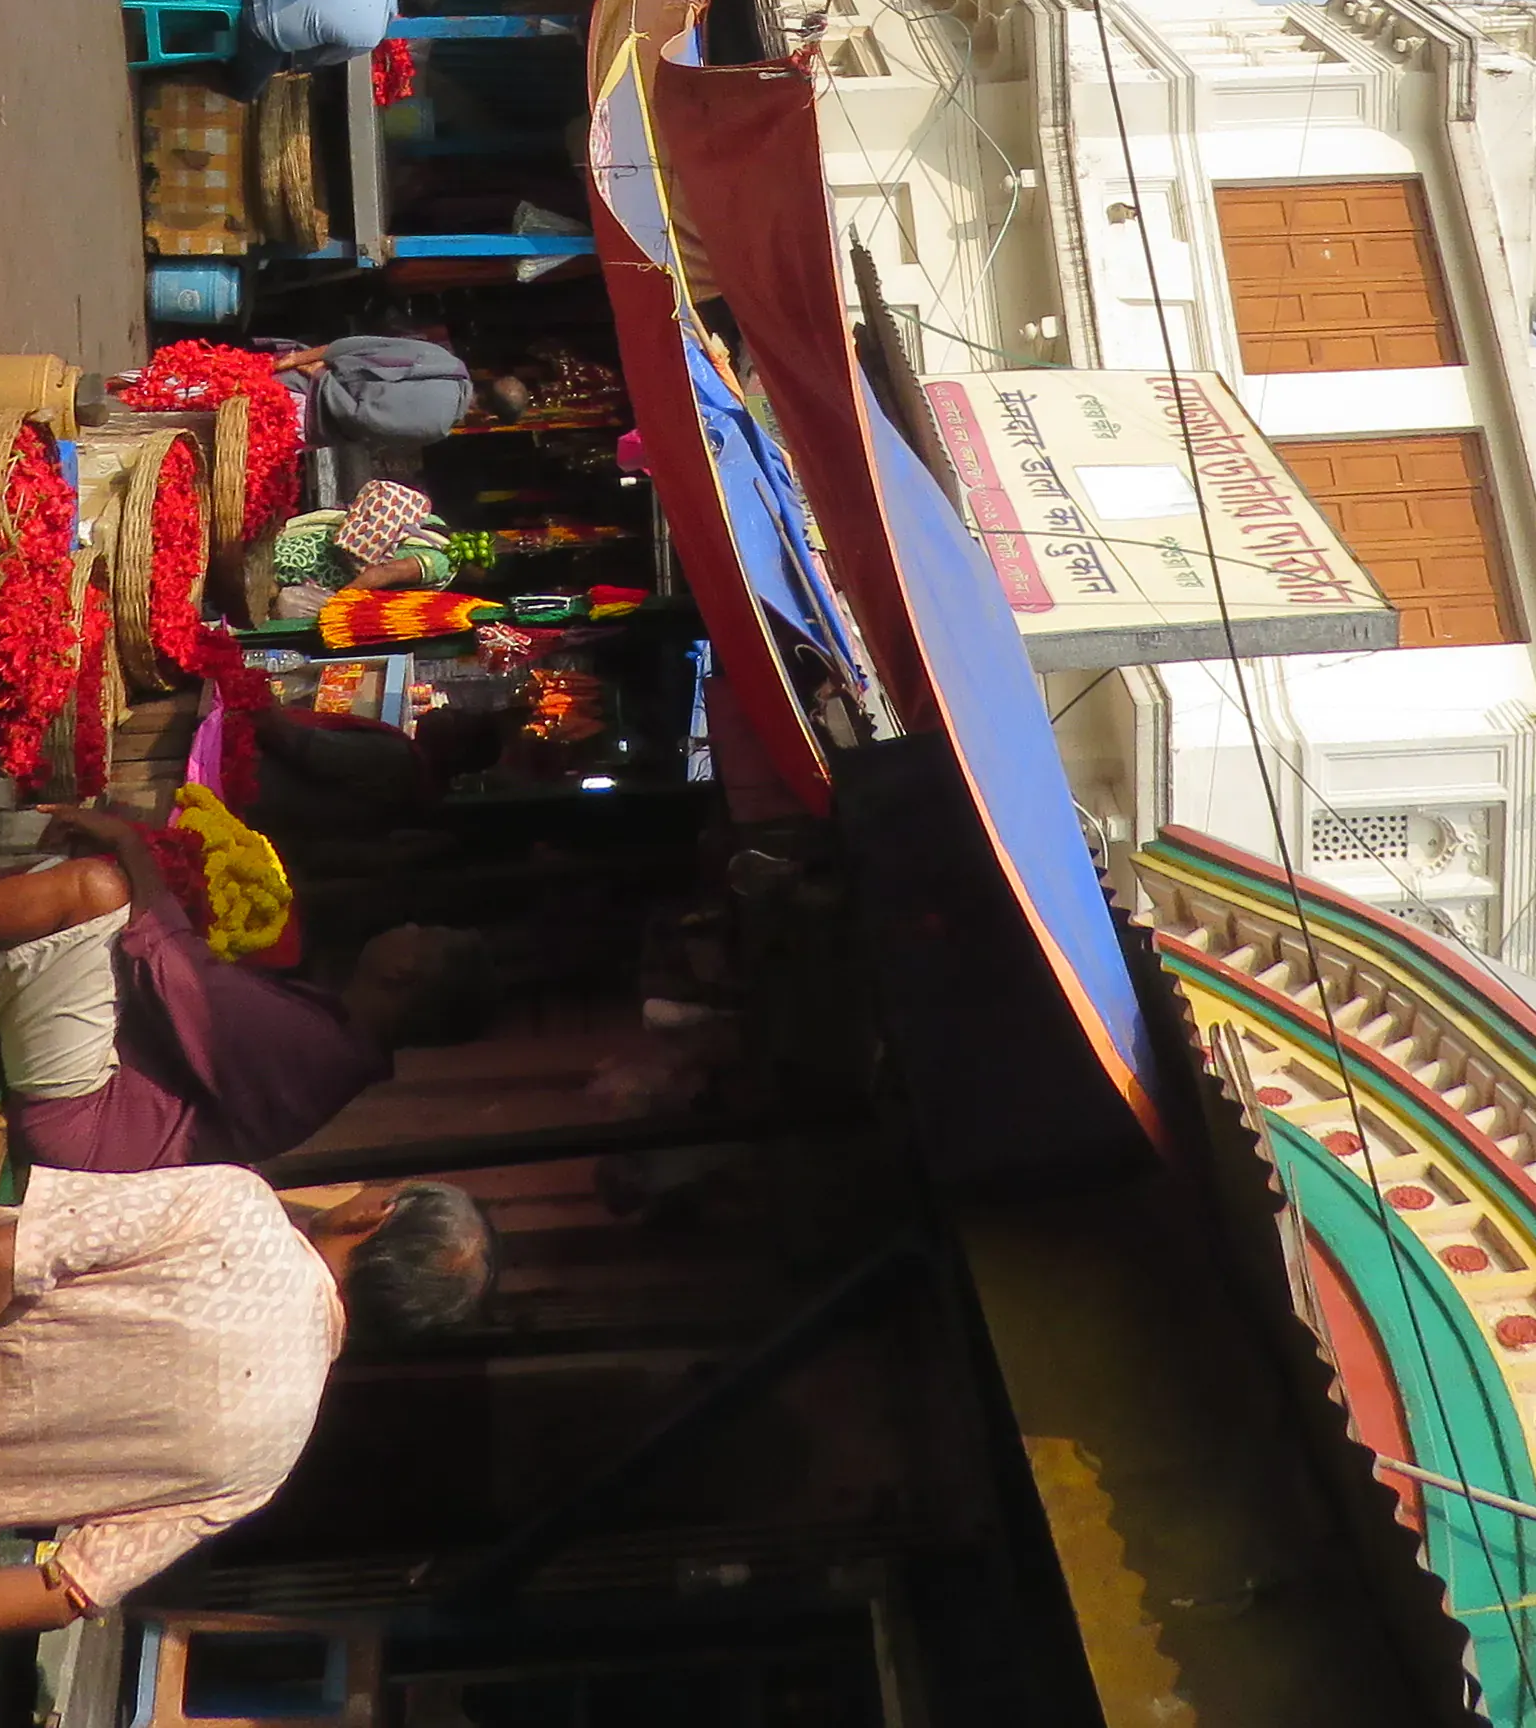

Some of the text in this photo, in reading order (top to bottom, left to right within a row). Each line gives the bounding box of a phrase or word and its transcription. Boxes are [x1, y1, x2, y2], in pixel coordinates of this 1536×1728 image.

[995, 389, 1047, 451] मेजदार
[1198, 457, 1293, 519] ডালার
[1042, 505, 1086, 534] का
[1045, 541, 1117, 594] दुकान
[1242, 523, 1353, 604] দোকান
